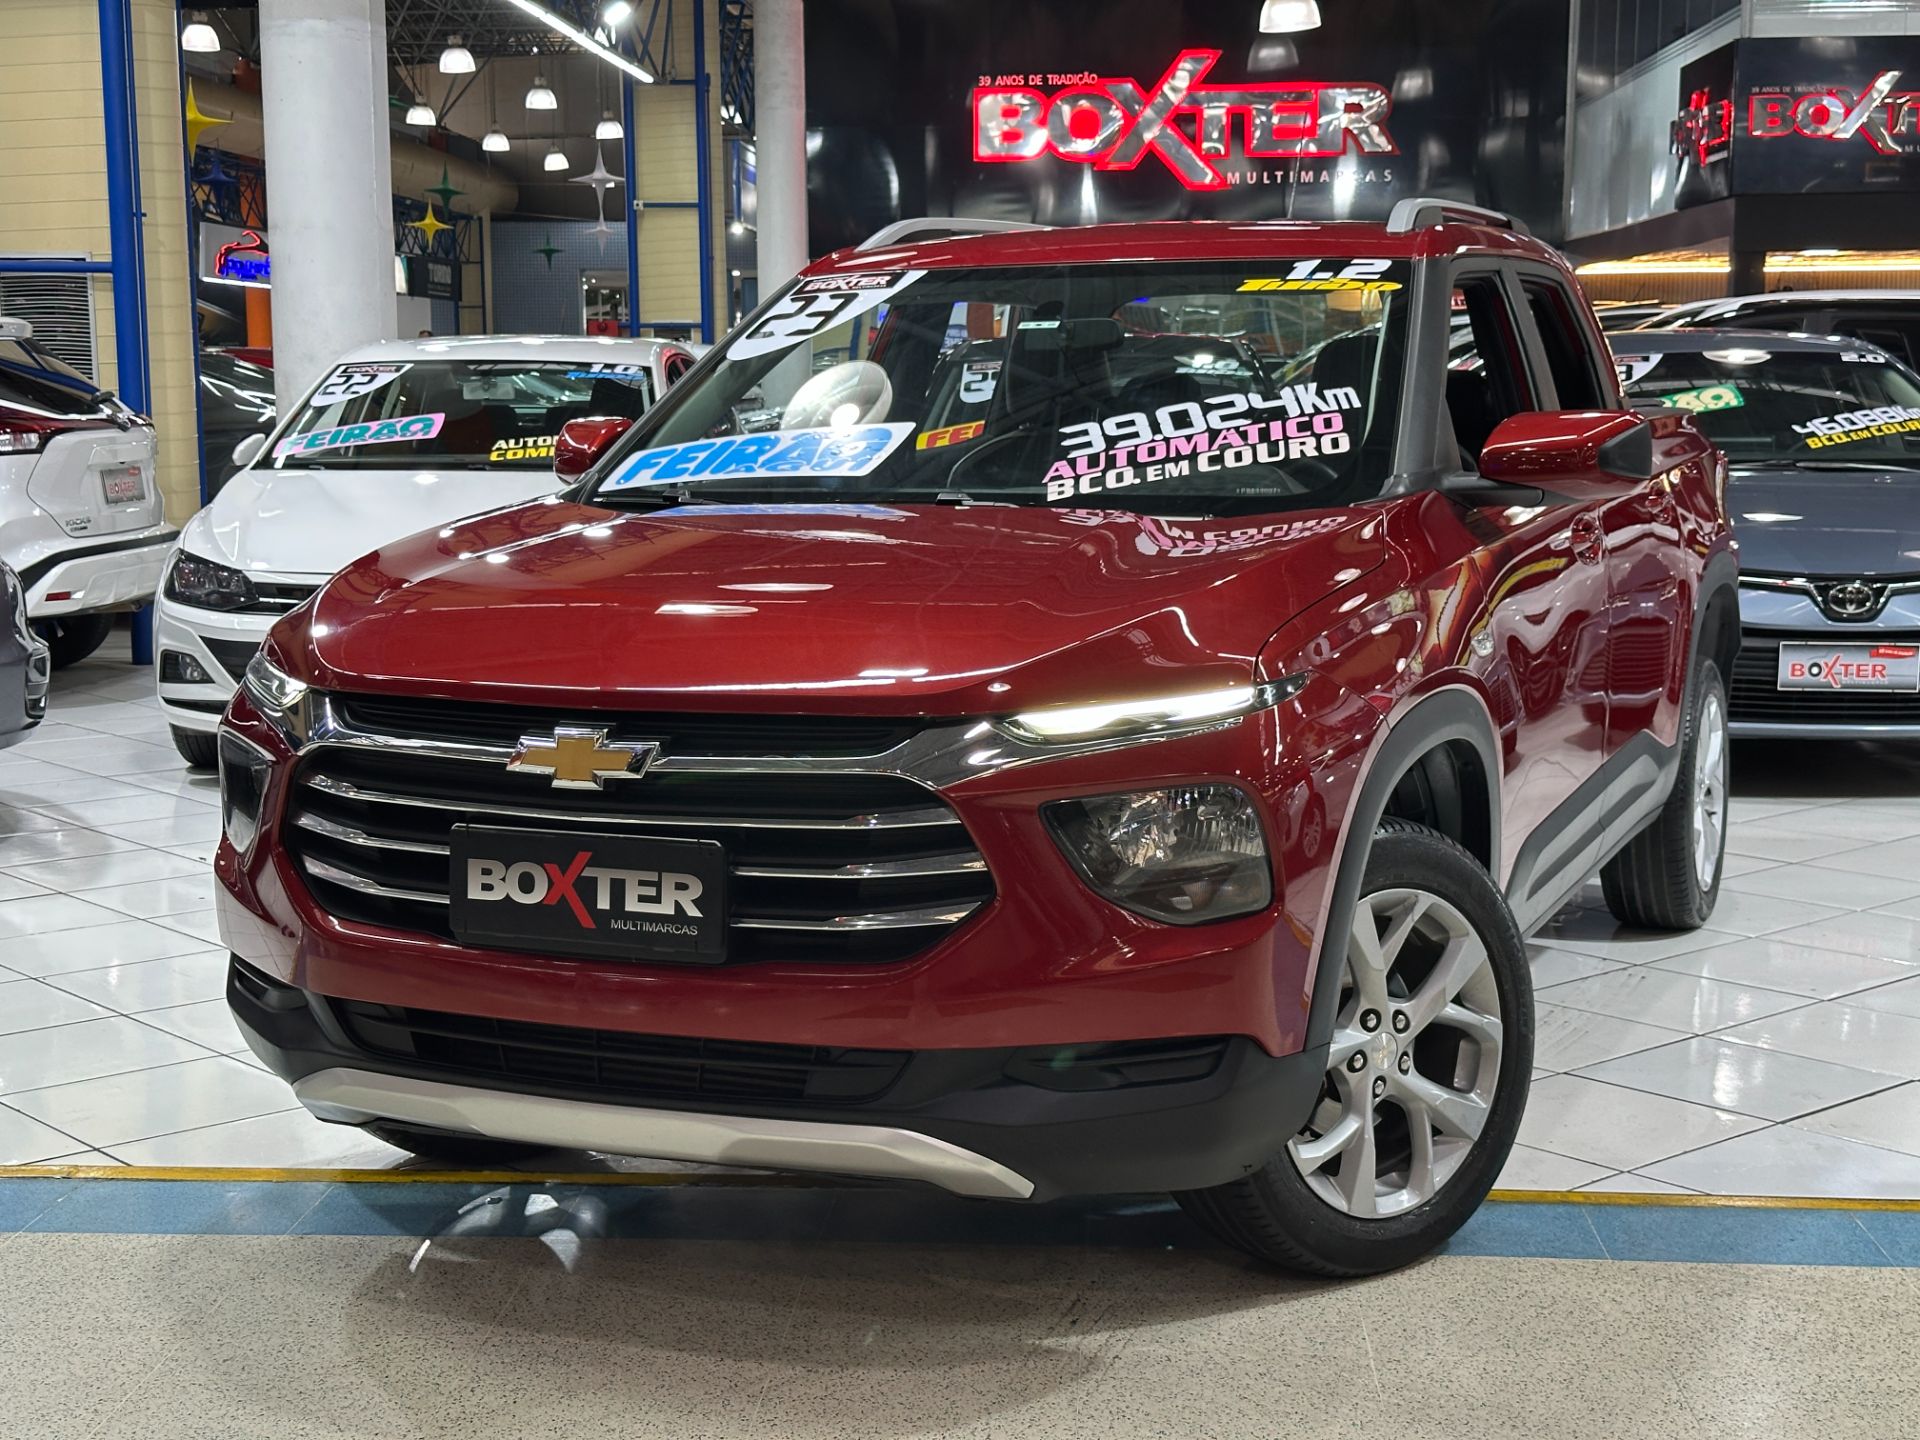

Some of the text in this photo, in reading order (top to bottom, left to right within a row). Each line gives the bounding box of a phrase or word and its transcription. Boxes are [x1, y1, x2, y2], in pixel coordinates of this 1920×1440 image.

[978, 72, 1098, 86] 39 ANOS DE TRADIÇÃO
[973, 48, 1400, 190] BOXTER
[1748, 70, 1920, 155] BOXT
[1285, 259, 1392, 280] 1.2
[803, 275, 891, 291] BOXTER
[745, 292, 860, 340] 23
[590, 363, 640, 374] 1.0
[1840, 352, 1885, 363] 2.0
[317, 373, 379, 396] 22
[492, 436, 560, 450] AUTO
[1849, 430, 1872, 441] EM
[616, 427, 893, 485] FEIRÃO
[1146, 459, 1190, 482] EM
[1197, 432, 1351, 472] COURO
[1789, 654, 1888, 688] BOXTER
[467, 851, 704, 929] BOXTER
[610, 918, 698, 936] MULTIMARCAS
